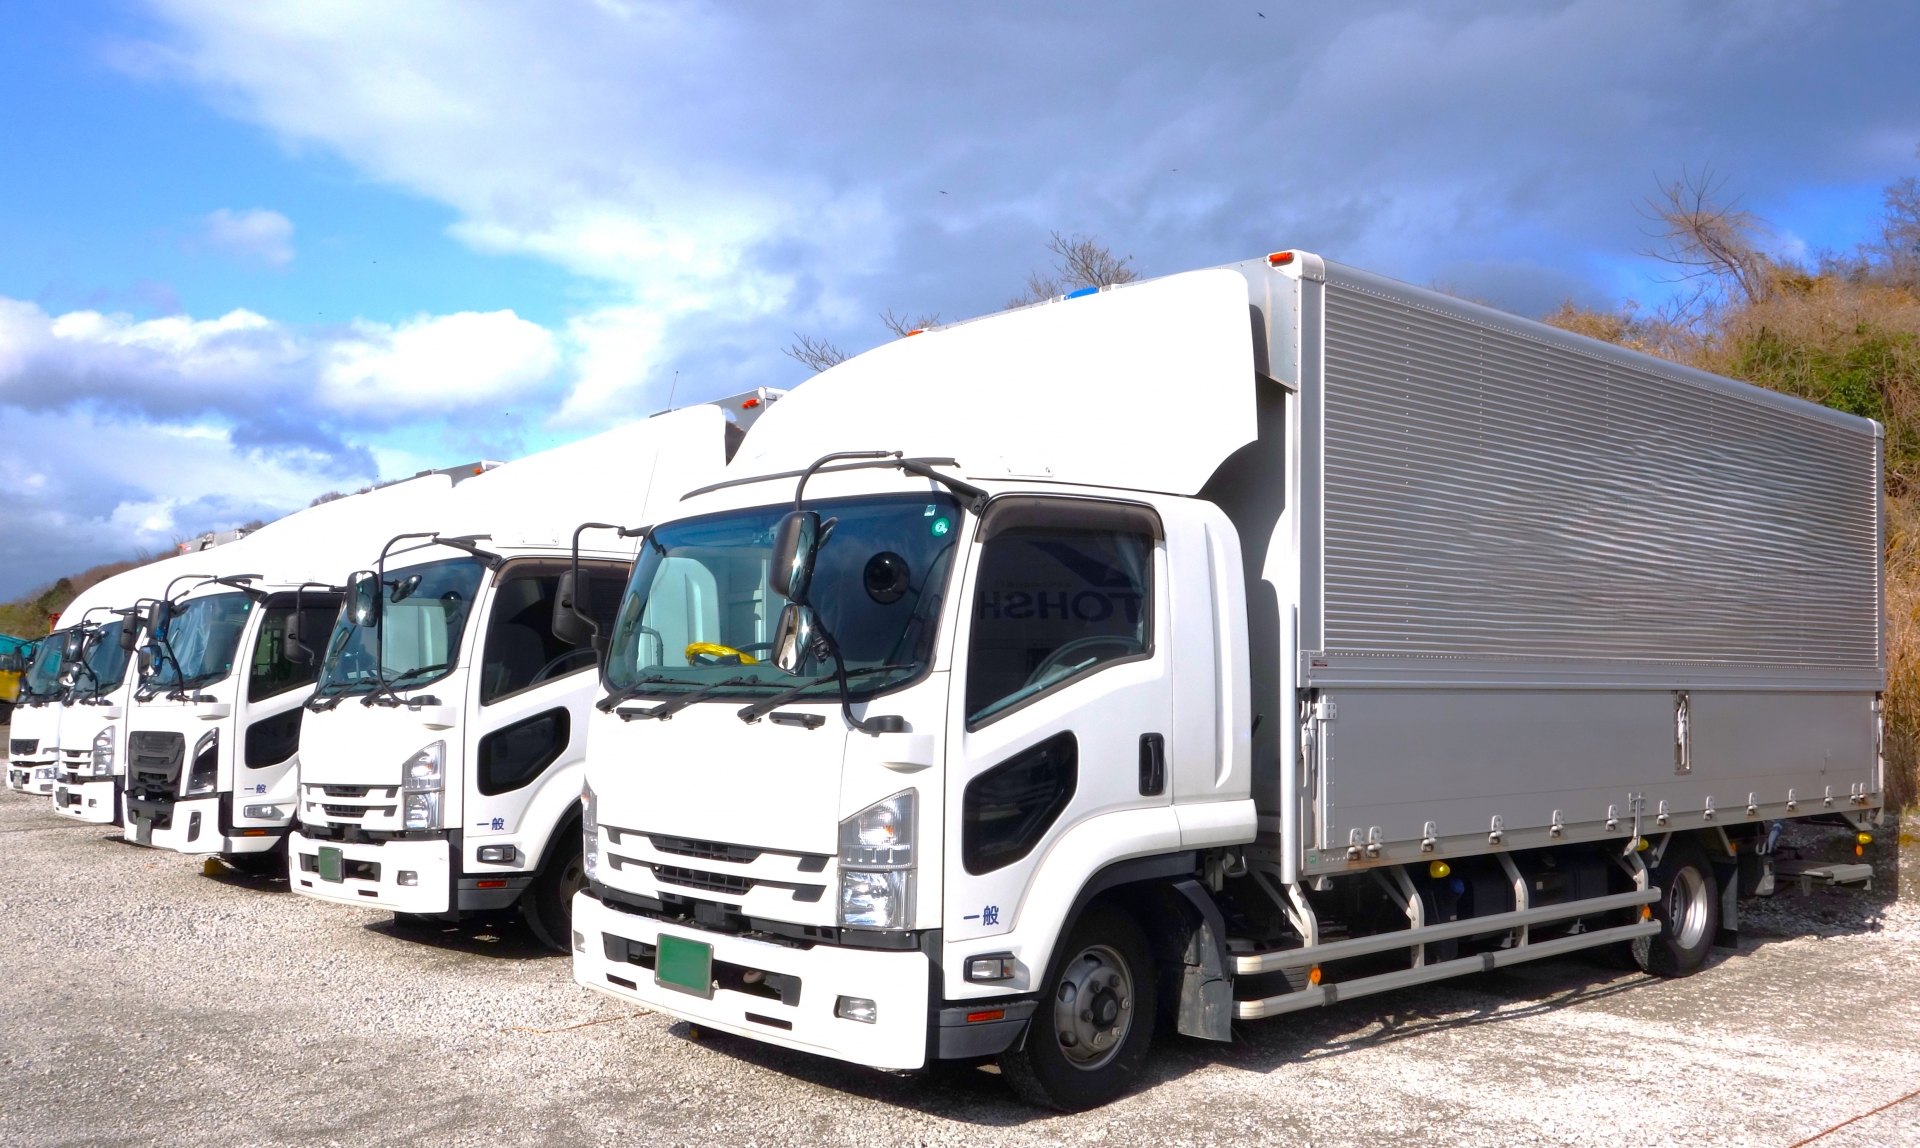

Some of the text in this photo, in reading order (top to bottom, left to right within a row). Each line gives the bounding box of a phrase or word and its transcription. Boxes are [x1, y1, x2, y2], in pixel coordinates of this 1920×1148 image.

[244, 783, 267, 794] 一般
[476, 817, 505, 831] 一般
[963, 905, 999, 926] 一般
